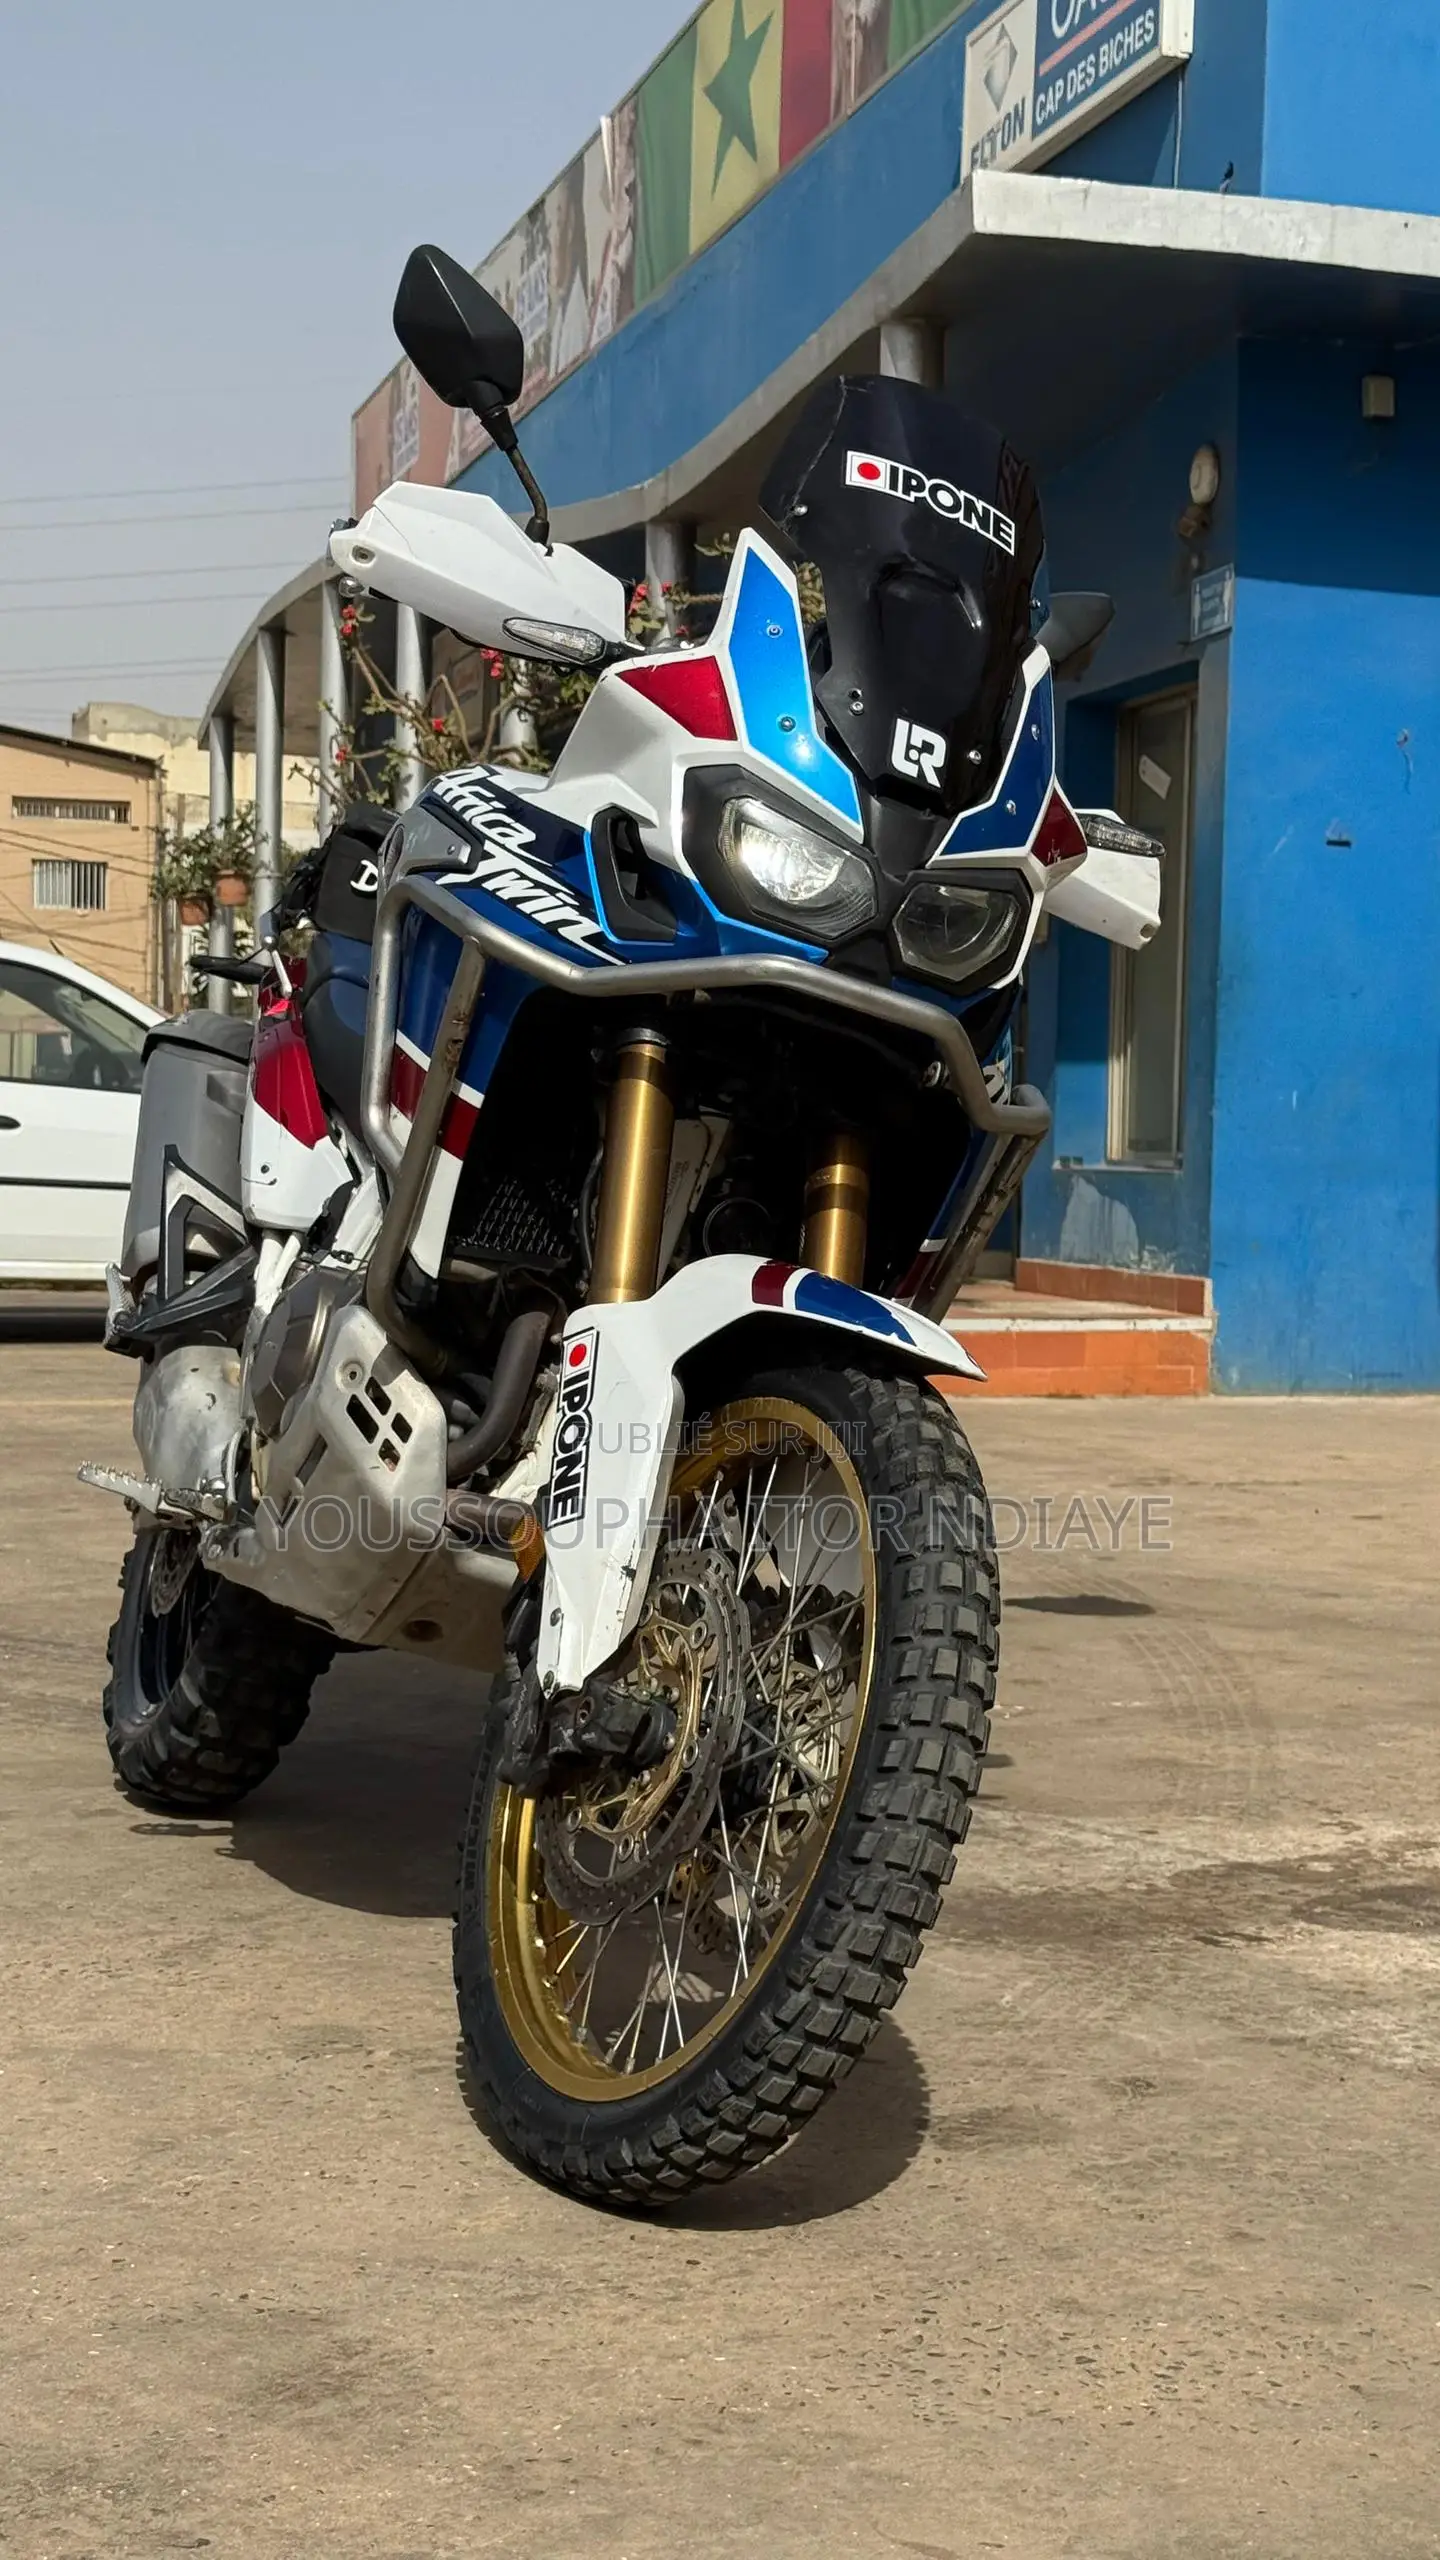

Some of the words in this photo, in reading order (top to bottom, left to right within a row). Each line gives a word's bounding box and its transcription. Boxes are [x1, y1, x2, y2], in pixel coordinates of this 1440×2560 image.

[1035, 81, 1063, 126] CAP
[1067, 54, 1096, 102] DES
[1099, 8, 1155, 78] BICHES
[888, 463, 1015, 556] IPONE
[432, 764, 553, 867] Africa
[436, 839, 626, 966] Twin
[547, 1368, 592, 1522] IPONE
